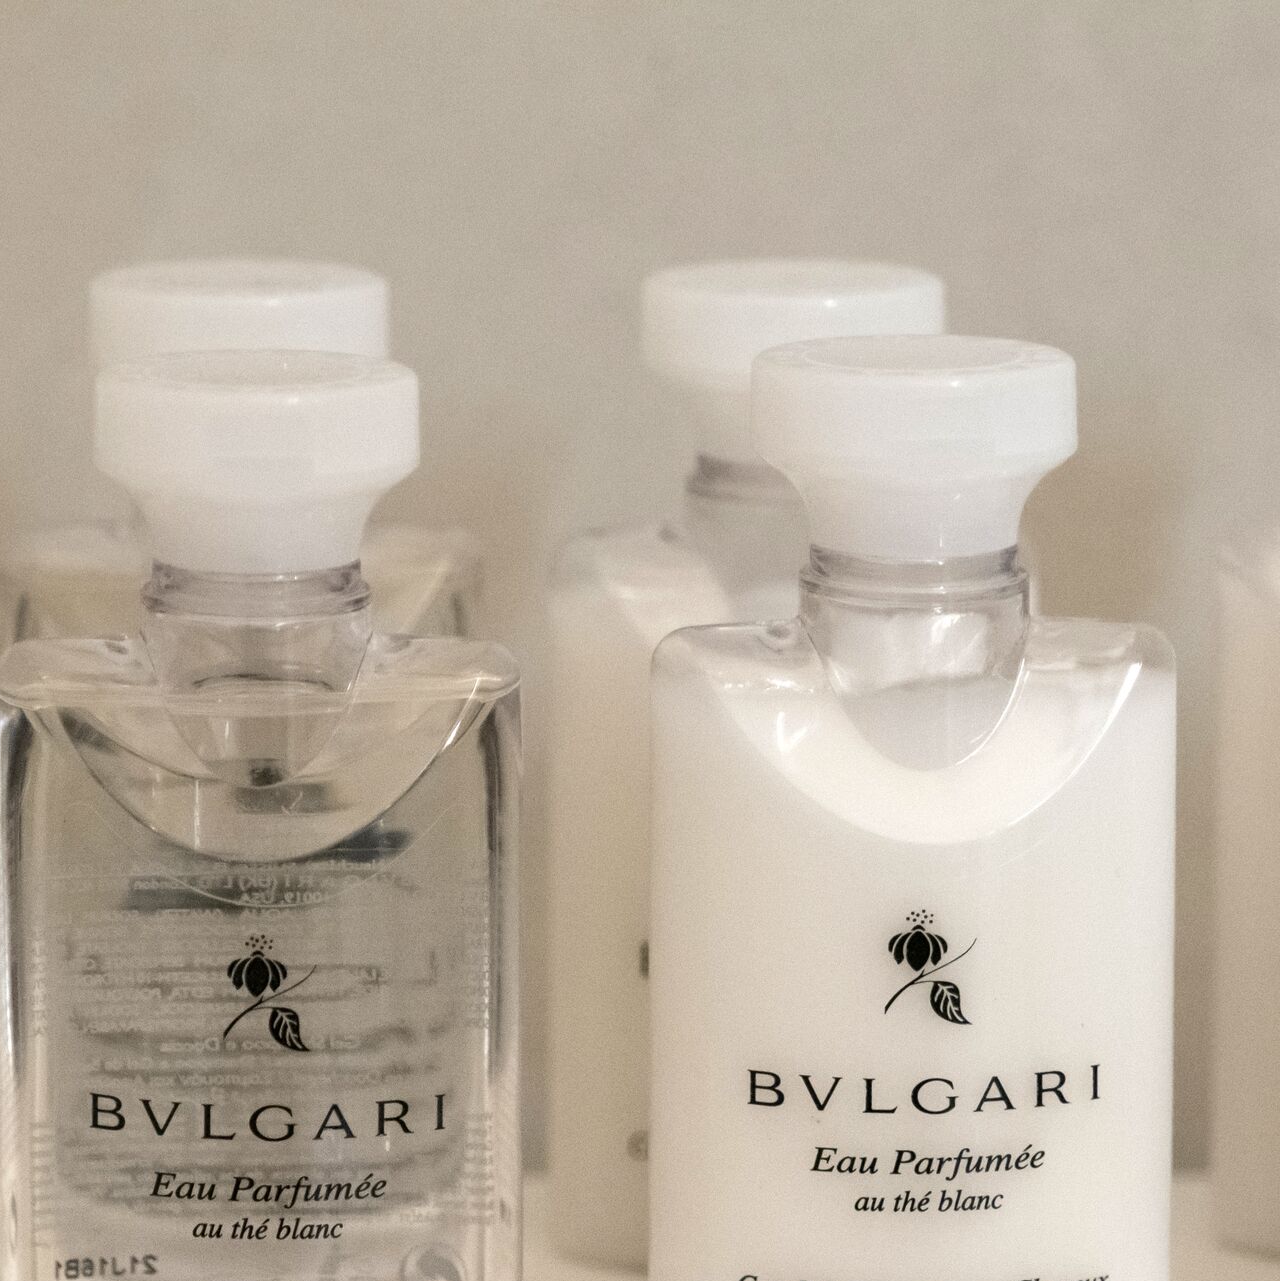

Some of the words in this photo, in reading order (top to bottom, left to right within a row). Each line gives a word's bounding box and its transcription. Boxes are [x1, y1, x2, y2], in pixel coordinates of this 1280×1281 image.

[748, 1064, 1099, 1115] BVLGARI
[90, 1092, 445, 1143] BVLGARI
[811, 1147, 878, 1175] Eau
[891, 1144, 1045, 1182] Parfumée
[151, 1171, 216, 1201] Eau
[228, 1173, 387, 1210] Parfumée
[854, 1196, 885, 1212] au
[893, 1190, 930, 1213] thé
[937, 1189, 1004, 1212] blanc
[192, 1223, 223, 1239] au
[230, 1217, 270, 1240] thé
[275, 1217, 344, 1240] blanc
